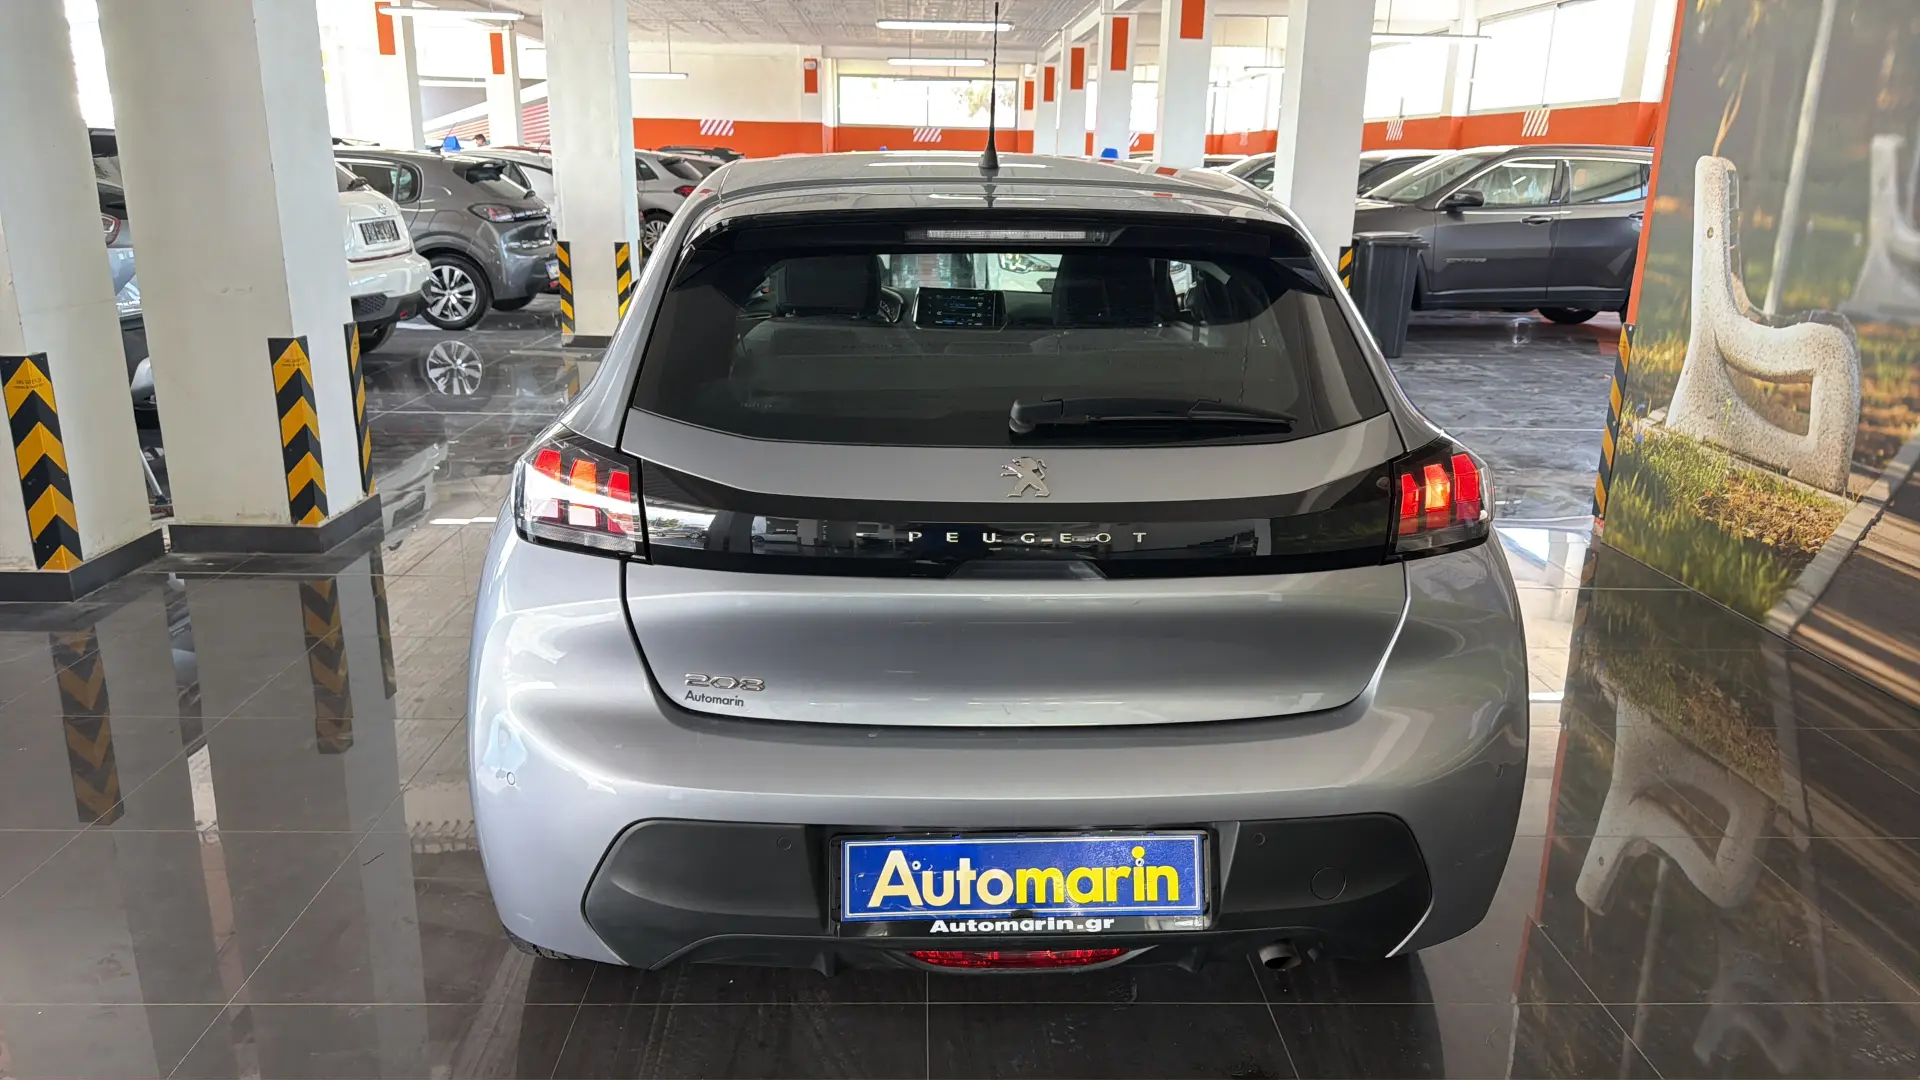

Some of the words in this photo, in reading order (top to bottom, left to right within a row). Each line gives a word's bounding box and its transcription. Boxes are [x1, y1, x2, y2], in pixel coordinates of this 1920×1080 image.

[908, 532, 1147, 543] PEUGEOT
[684, 672, 766, 691] 208
[685, 690, 744, 707] Automarin
[867, 846, 1180, 908] Automarin
[930, 917, 1115, 933] Automarin.gr
